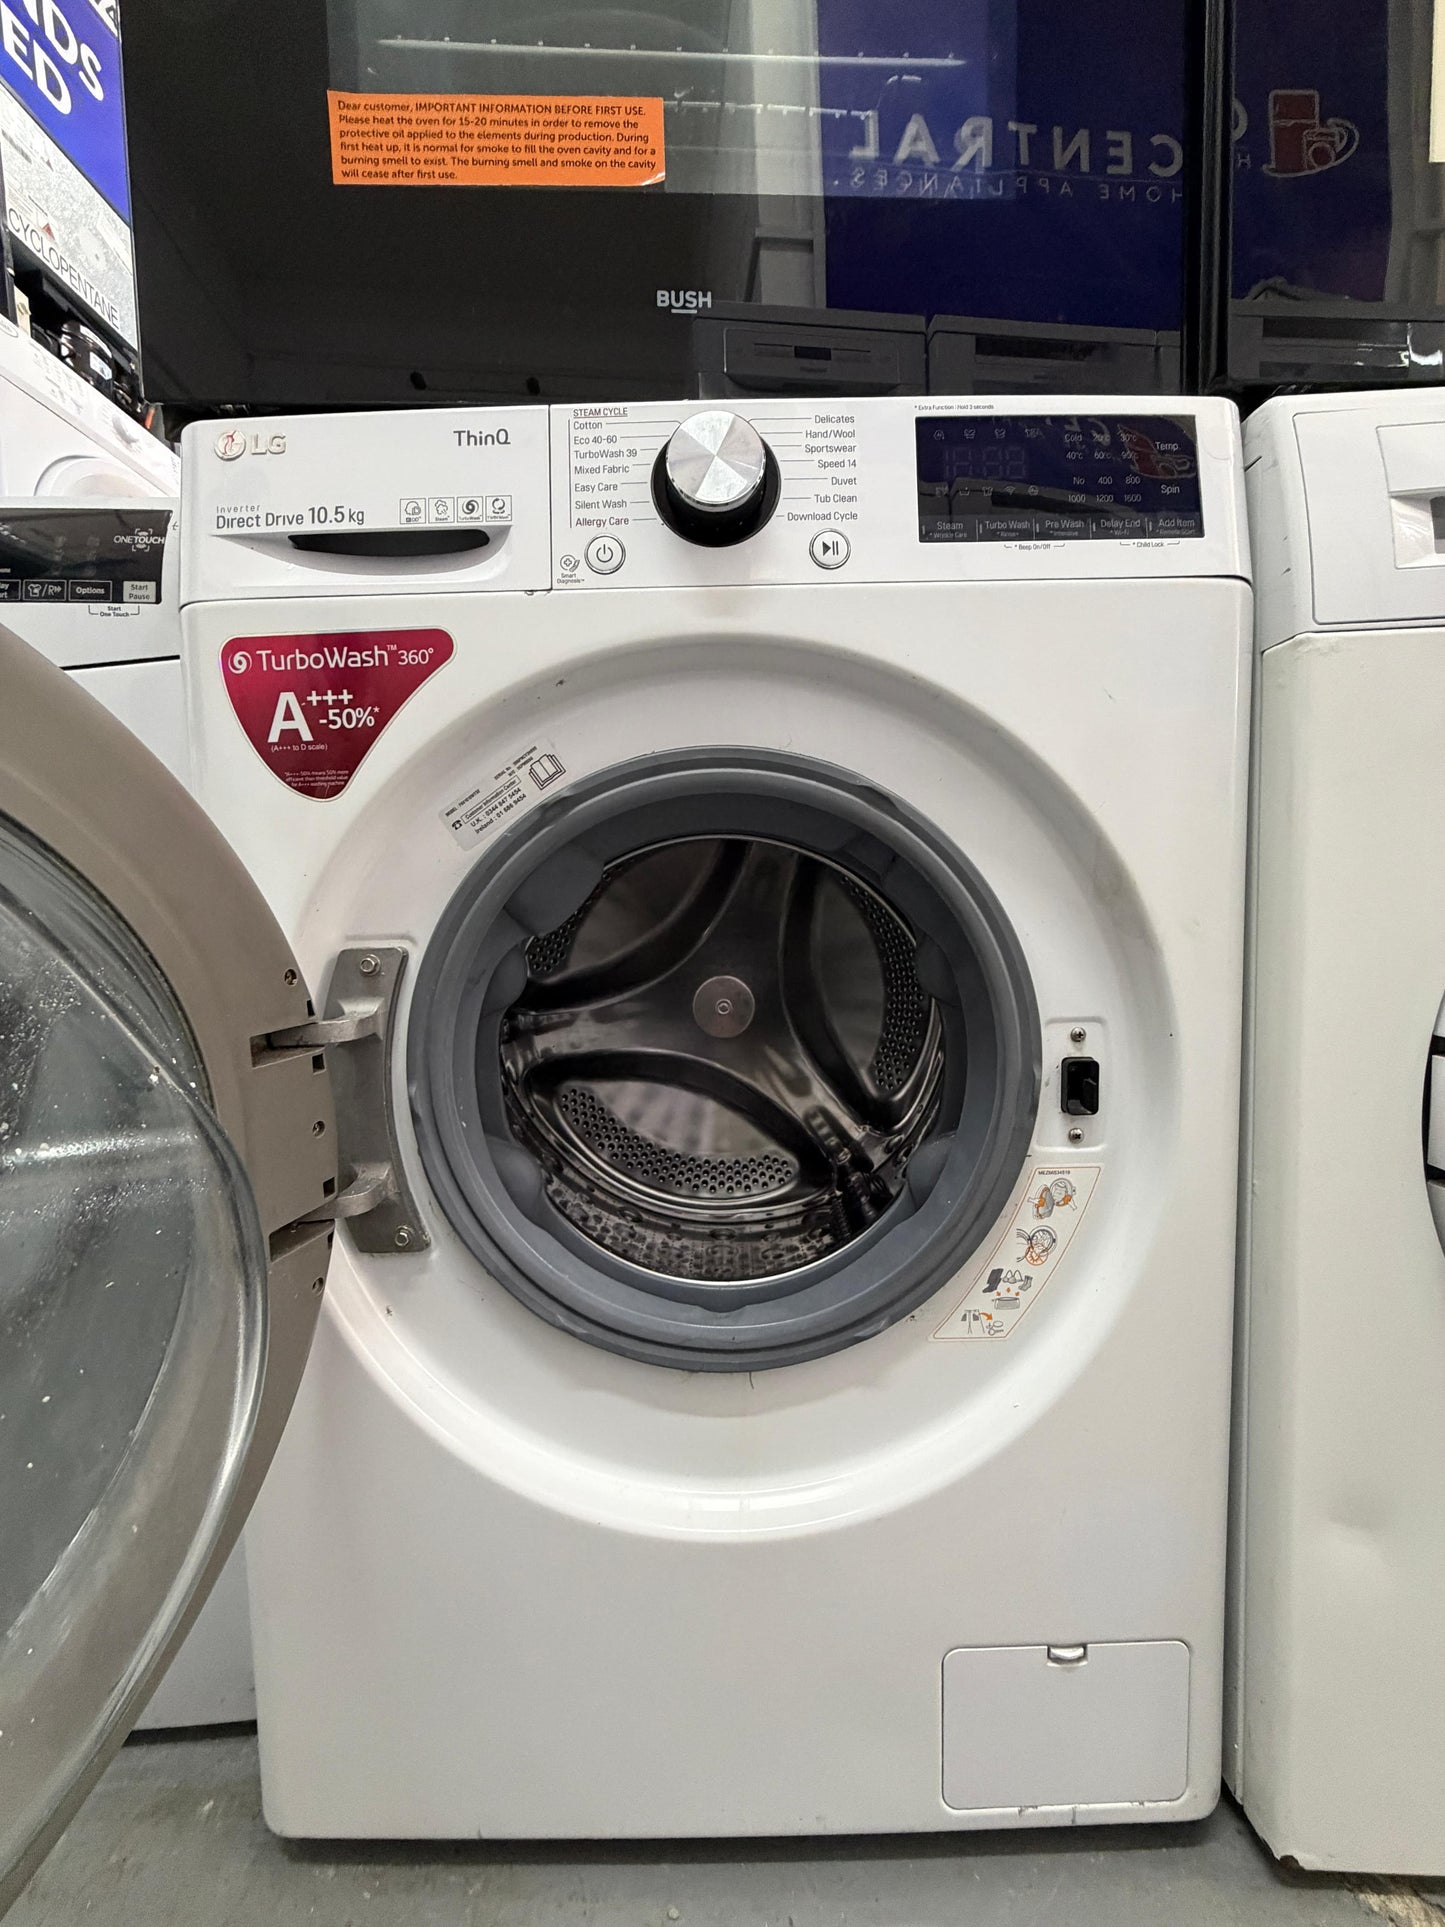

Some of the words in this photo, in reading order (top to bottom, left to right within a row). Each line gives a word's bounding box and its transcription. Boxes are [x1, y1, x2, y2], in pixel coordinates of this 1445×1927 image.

[338, 100, 360, 111] Dear
[364, 103, 413, 112] customer,
[416, 103, 476, 112] IMPORTANT
[479, 103, 552, 114] INFORMATION
[555, 105, 592, 114] BEFORE
[595, 106, 622, 115] FIRST
[624, 106, 645, 116] USE.
[339, 115, 370, 124] Please
[373, 116, 394, 124] heat
[397, 116, 412, 125] the
[442, 116, 456, 125] for
[459, 117, 487, 126] 15-20
[490, 119, 528, 127] minutes
[531, 119, 539, 127] in
[543, 119, 568, 127] order
[572, 120, 581, 128] to
[623, 120, 638, 129] the
[340, 129, 389, 139] protective
[392, 130, 404, 138] oil
[407, 131, 443, 143] applied
[459, 131, 474, 139] the
[477, 131, 522, 140] elements
[524, 132, 555, 142] during
[558, 133, 614, 142] production.
[617, 134, 648, 143] During
[341, 143, 359, 151] first
[362, 143, 383, 151] heat
[386, 145, 400, 154] up,
[413, 144, 420, 152] is
[423, 144, 457, 152] normal
[461, 143, 473, 153] for
[476, 144, 508, 153] smoke
[525, 145, 536, 153] fill
[539, 145, 555, 154] the
[584, 146, 611, 157] cavity
[614, 147, 631, 155] and
[634, 146, 647, 156] for
[341, 155, 379, 167] burning
[383, 156, 408, 164] smell
[411, 157, 421, 165] to
[424, 157, 447, 165] exist.
[451, 157, 469, 166] The
[472, 156, 510, 168] burning
[512, 158, 537, 167] smell
[540, 159, 558, 167] and
[561, 159, 592, 167] smoke
[610, 160, 625, 168] the
[628, 160, 656, 170] cavity
[342, 169, 359, 178] will
[392, 170, 413, 178] after
[417, 170, 435, 179] first
[8, 207, 120, 331] CYCLOPENTANE
[656, 290, 712, 309] BUSH
[573, 408, 601, 417] STEAM
[815, 415, 855, 424] Delicates
[574, 421, 602, 430] Cotton
[453, 428, 511, 447] ThinQ
[805, 429, 855, 439] Hand/Wool
[250, 433, 287, 455] LG
[574, 436, 590, 444] Eco
[592, 435, 617, 443] 40-60
[805, 444, 856, 454] Sportswear
[1155, 441, 1178, 451] Temp
[575, 449, 624, 459] TurboWash
[626, 449, 637, 457] 39
[818, 460, 845, 469] Speed
[848, 459, 857, 467] 14
[575, 466, 600, 474] Mixed
[602, 465, 629, 473] Fabric
[831, 477, 857, 485] Duvet
[1073, 476, 1084, 484] No
[1098, 476, 1112, 484] 400
[1126, 476, 1140, 484] 800
[575, 483, 596, 493] Easy
[598, 483, 618, 491] Care
[1161, 485, 1180, 494] Spin
[814, 494, 831, 502] Tub
[833, 494, 857, 502] Clean
[1068, 494, 1085, 503] 1000
[1096, 494, 1114, 503] 1200
[216, 503, 261, 514] Inverter
[575, 501, 603, 509] Silent
[605, 500, 627, 508] Wash
[216, 514, 261, 529] Direct
[265, 510, 304, 526] Drive
[308, 506, 345, 524] 10.5
[348, 507, 365, 525] kg
[787, 512, 831, 521] Download
[833, 512, 858, 522] Cycle
[576, 517, 607, 528] Allergy
[609, 517, 629, 525] Care
[937, 521, 963, 530] Steam
[985, 521, 1007, 529] Turbo
[1046, 520, 1058, 528] Pre
[1061, 520, 1084, 528] Wash
[1100, 519, 1123, 529] Delay
[1125, 519, 1140, 527] End
[1159, 519, 1175, 527] Add
[114, 535, 165, 544] ONETOUCH
[75, 586, 105, 595] Options
[398, 648, 434, 665] 360°
[267, 689, 353, 743] A+++
[308, 743, 328, 751] scale)
[475, 819, 494, 834] Ireland
